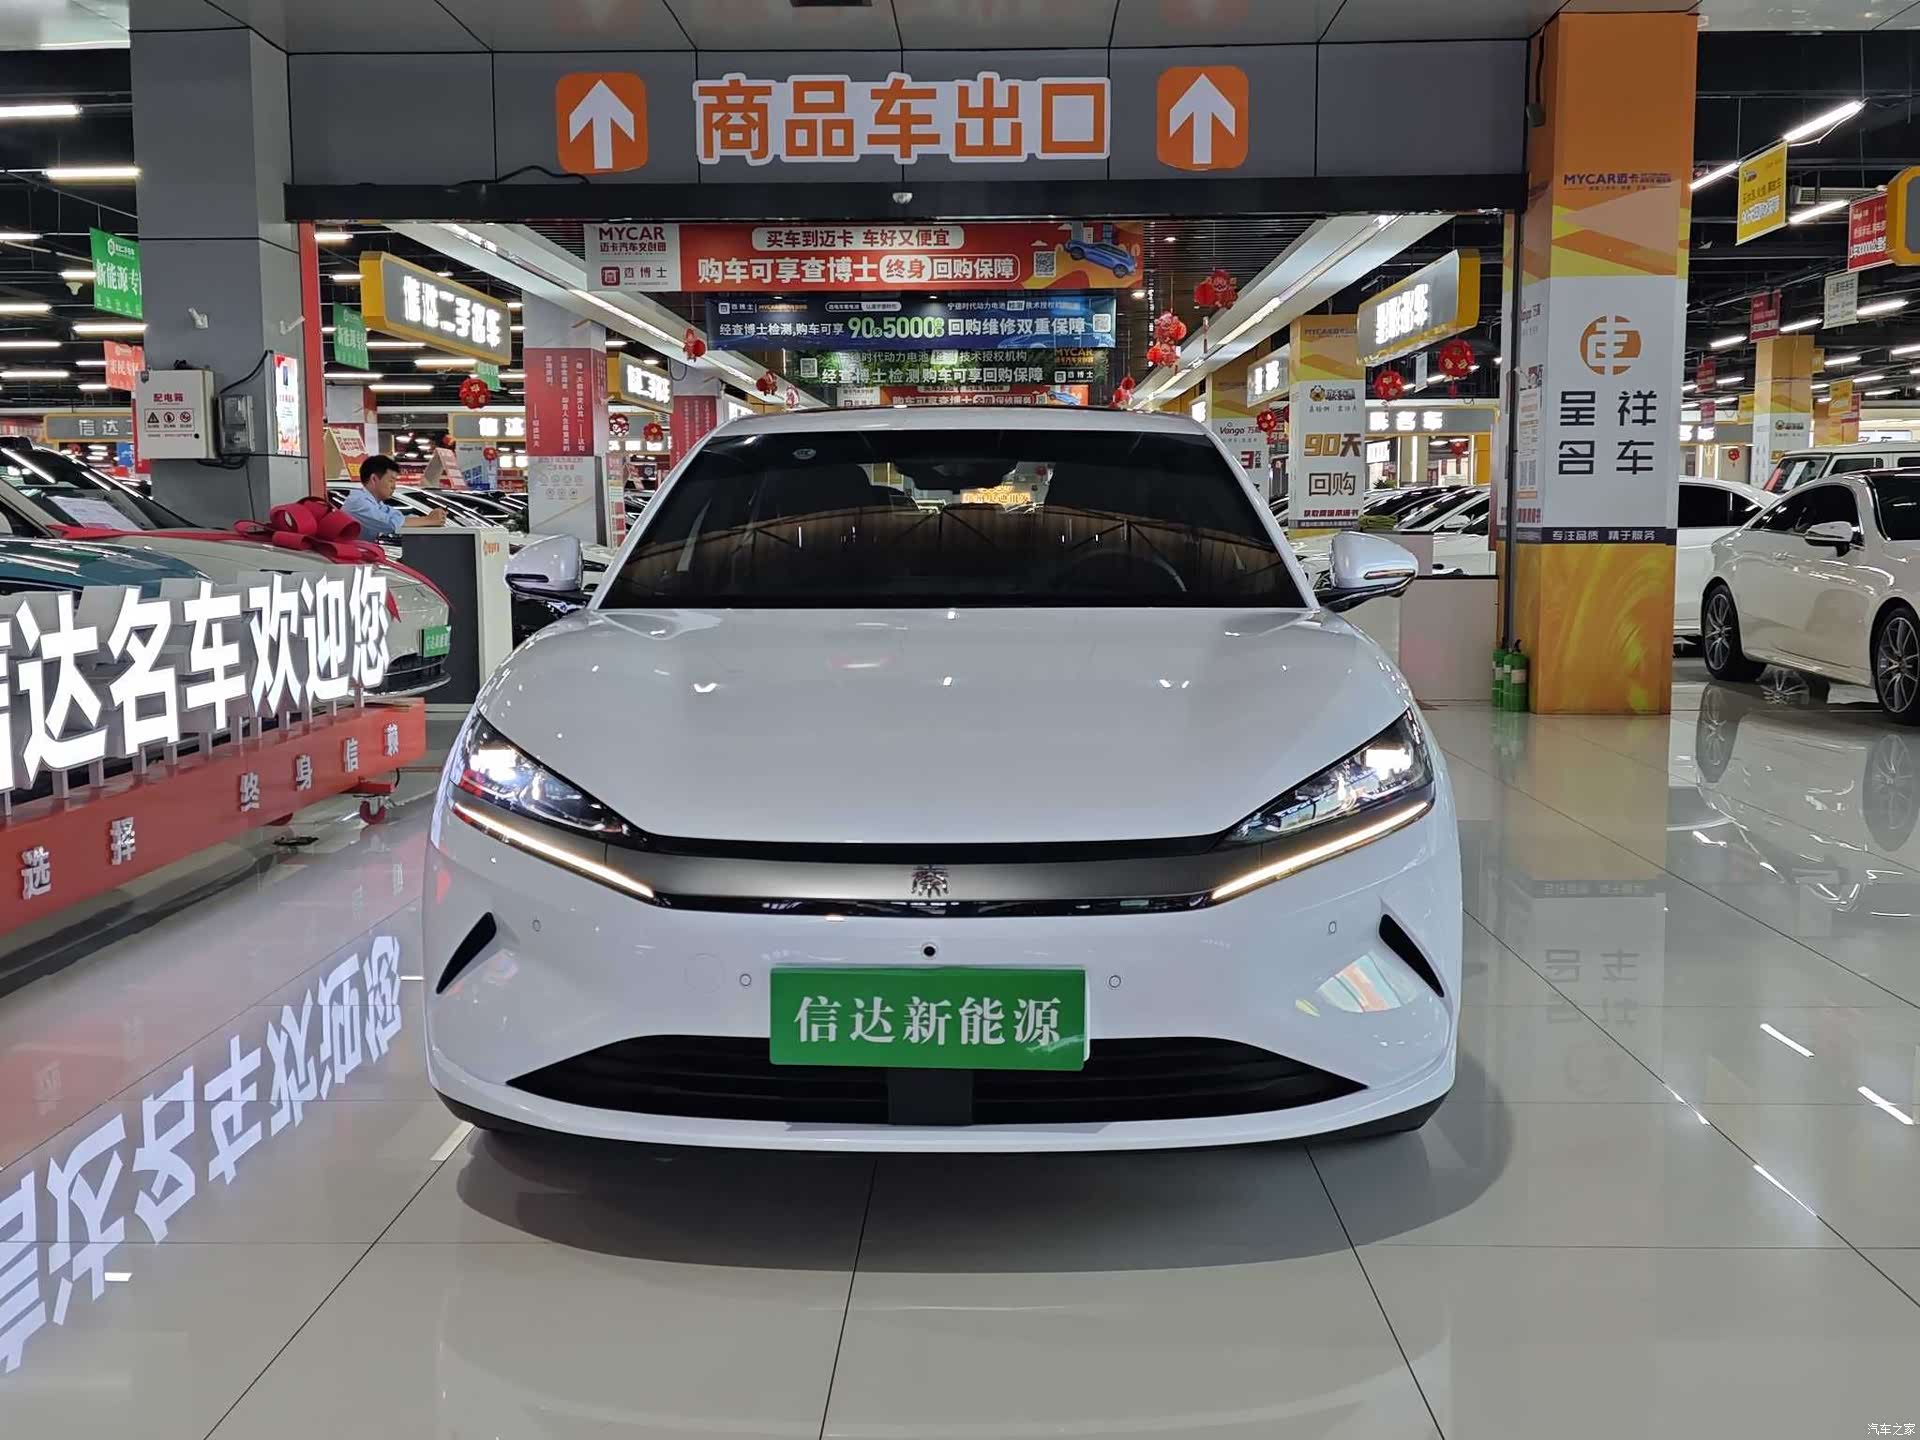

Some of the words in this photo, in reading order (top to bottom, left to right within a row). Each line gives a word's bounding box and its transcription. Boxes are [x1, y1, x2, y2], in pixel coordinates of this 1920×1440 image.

[695, 77, 1107, 161] 商品车出口
[600, 226, 665, 241] MYCAR
[766, 230, 854, 247] 买车到迈卡
[862, 229, 950, 247] 车好又便宜
[96, 257, 143, 296] 新能源专
[719, 322, 844, 337] 经查博士检测,购车可享
[948, 318, 1086, 336] 回购维修双重保障
[153, 392, 184, 402] 配电箱
[1559, 390, 1658, 427] 呈祥
[1220, 426, 1245, 436] Vango
[1303, 433, 1362, 457] 90天
[1557, 439, 1656, 475] 名车
[1241, 450, 1255, 469] 3
[1309, 472, 1356, 496] 回购
[1552, 530, 1599, 541] 专注品质
[1608, 530, 1656, 541] 精于服务
[0, 567, 391, 793] 达名车欢迎您
[793, 995, 1063, 1047] 信达新能源
